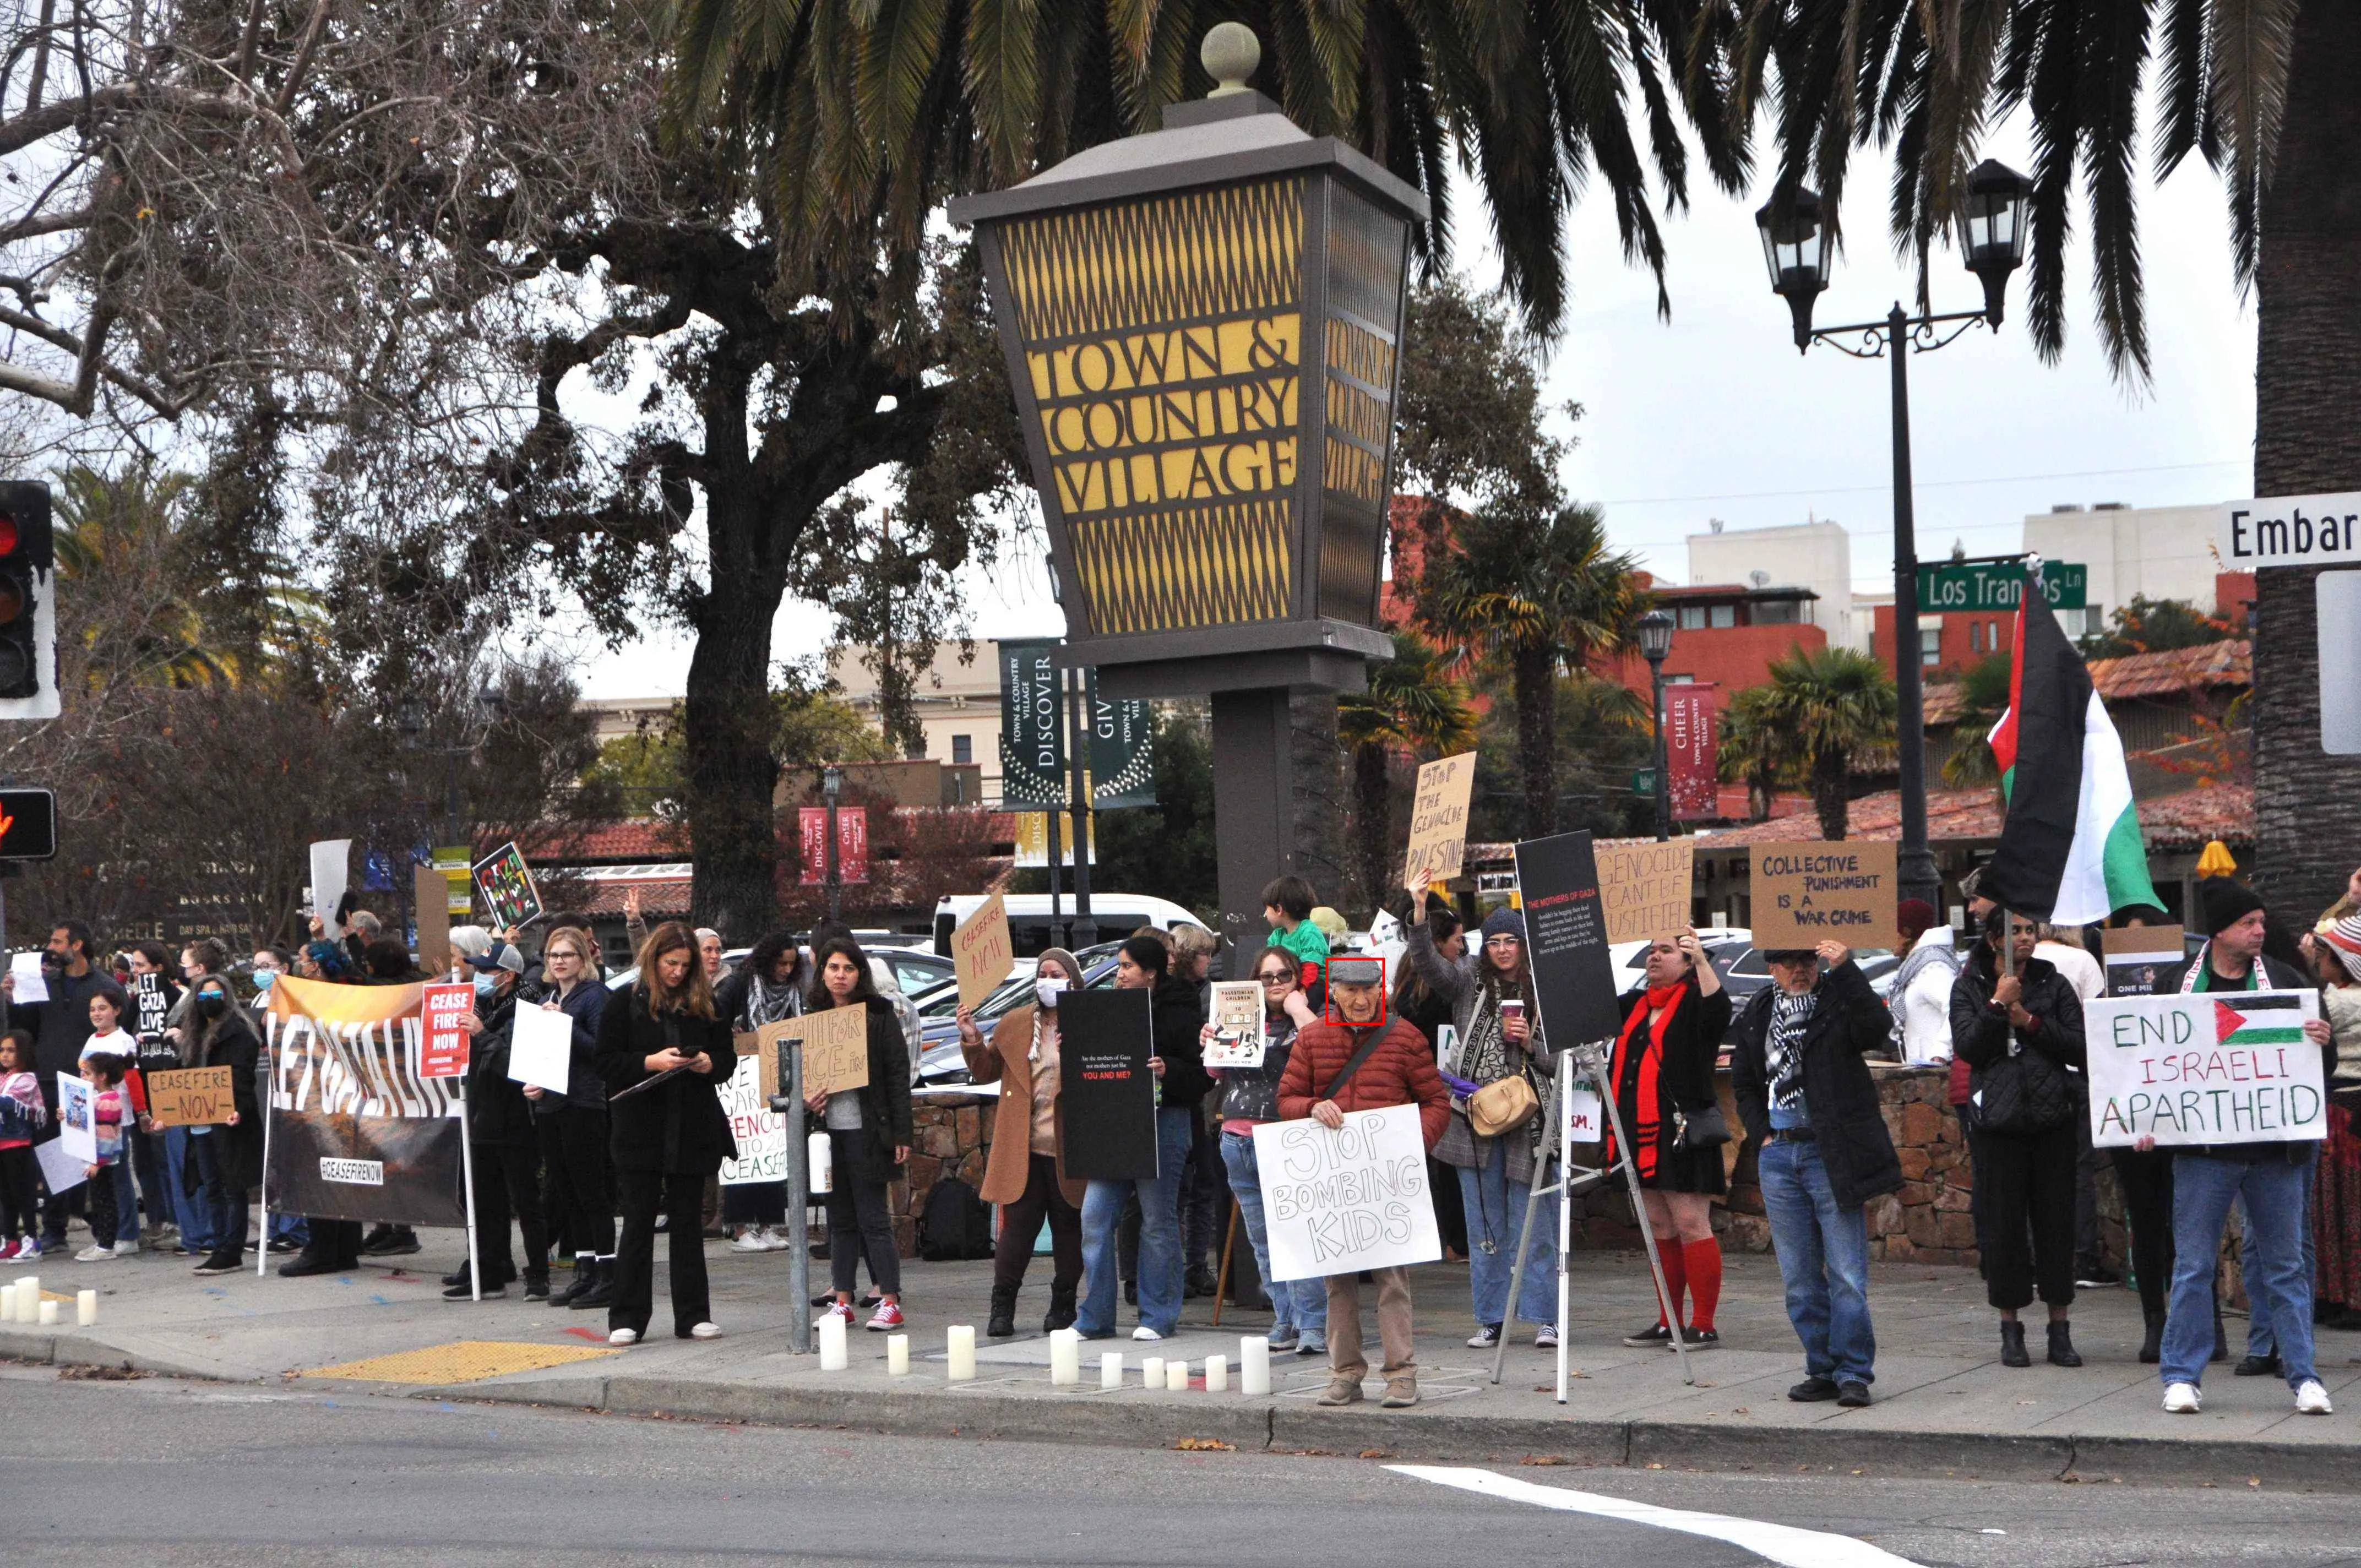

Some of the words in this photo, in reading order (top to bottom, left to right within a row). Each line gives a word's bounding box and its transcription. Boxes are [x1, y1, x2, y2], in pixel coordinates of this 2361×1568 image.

[1029, 325, 1221, 400] TOWN
[1248, 319, 1290, 370] &
[1325, 318, 1377, 386] TOWN
[1049, 375, 1295, 453] COUNTRY
[1326, 378, 1389, 447] COUNTRY
[1054, 436, 1297, 511] VILLAGE
[1929, 573, 1966, 605] Los
[2065, 570, 2081, 587] Ln
[1010, 657, 1020, 703] COUNTRY
[1021, 680, 1030, 720] VILLAGE
[1035, 655, 1054, 766] DISCOVER
[1013, 714, 1021, 744] TOWN
[1123, 715, 1131, 743] TOWN
[1674, 698, 1687, 749] CHEER
[1421, 762, 1456, 791] STOP
[1418, 792, 1441, 812] THE
[1597, 845, 1690, 886] GENOCIDE
[1763, 855, 1858, 876] COLLECTIVE
[1803, 874, 1880, 891] PUNISHMENT
[1607, 879, 1655, 910] CAN'T
[1661, 875, 1683, 899] BE
[1778, 895, 1790, 908] IS
[1801, 895, 1813, 907] A
[1604, 901, 1690, 937] USTIFIED
[1794, 910, 1829, 925] WAR
[1830, 910, 1872, 925] CRIME
[138, 973, 157, 993] LET
[139, 992, 166, 1011] GAZA
[431, 993, 468, 1009] CEASE
[140, 1012, 165, 1032] LIVE
[433, 1013, 460, 1030] FIRE
[2113, 1011, 2193, 1048] END
[432, 1033, 459, 1050] NOW
[150, 1071, 230, 1092] CEASEFIRE
[2140, 1049, 2289, 1084] ISRAELI
[179, 1093, 217, 1119] NOW
[2100, 1085, 2320, 1135] APARTHEID
[1281, 1114, 1386, 1181] STOP
[322, 1162, 381, 1180] #CEASEFIRENOW
[1273, 1155, 1422, 1221] BOMBING
[1308, 1201, 1412, 1262] KIDS
